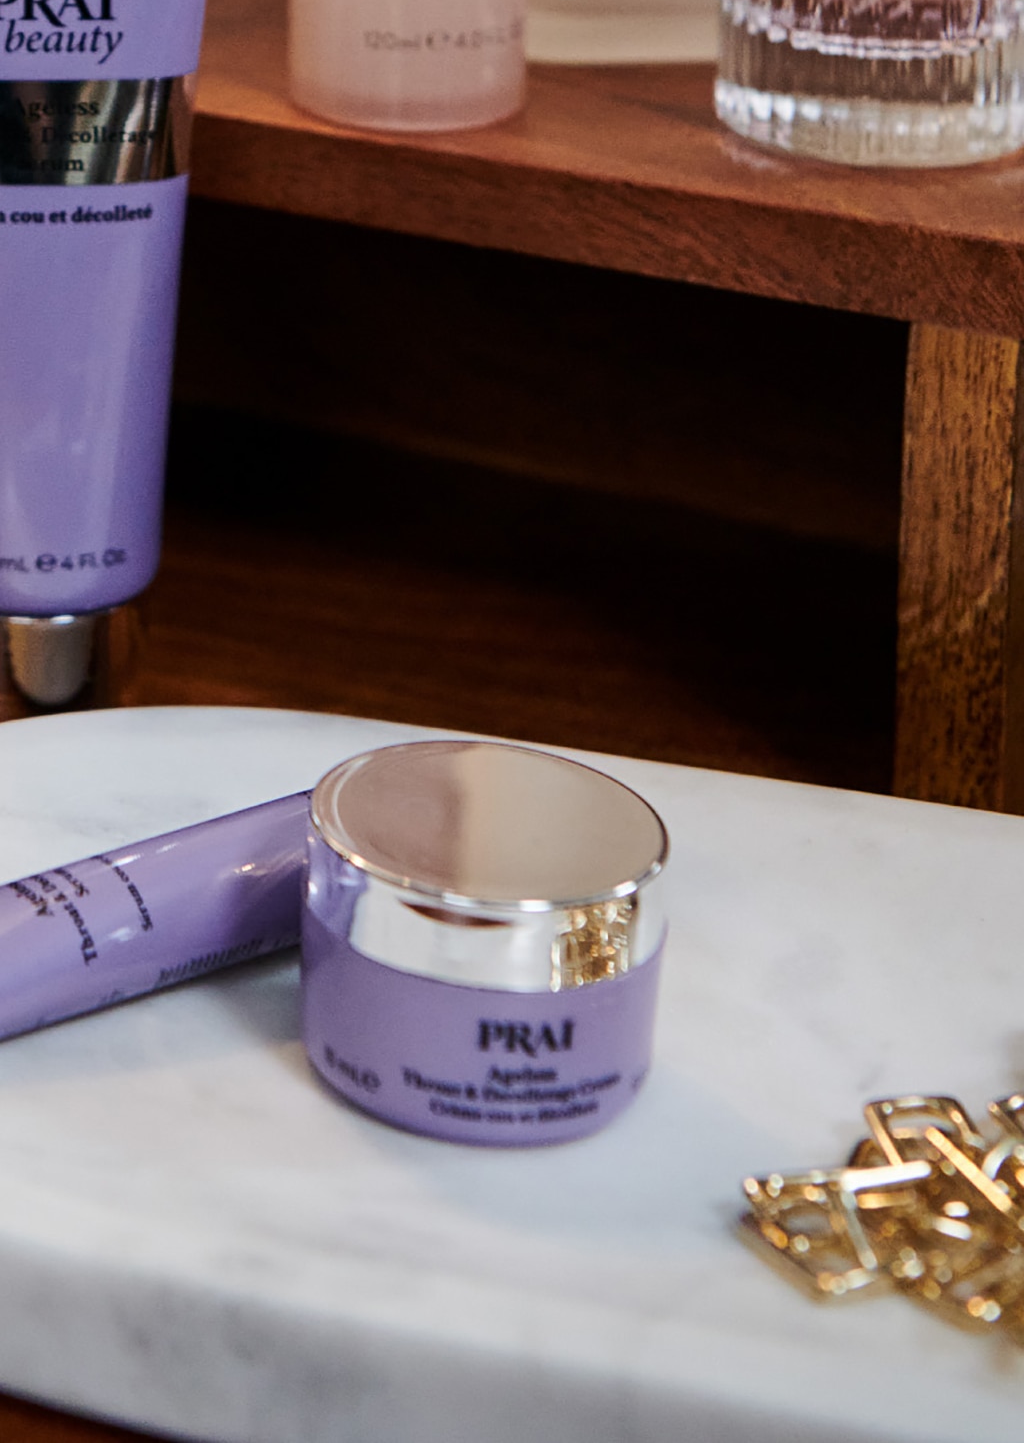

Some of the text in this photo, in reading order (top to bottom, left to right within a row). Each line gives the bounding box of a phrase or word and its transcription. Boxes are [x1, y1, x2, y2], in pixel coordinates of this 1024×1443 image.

[4, 20, 124, 65] beauty
[10, 209, 44, 224] cou
[49, 208, 67, 223] et
[71, 203, 153, 224] décolleté
[478, 1019, 577, 1058] PRAI
